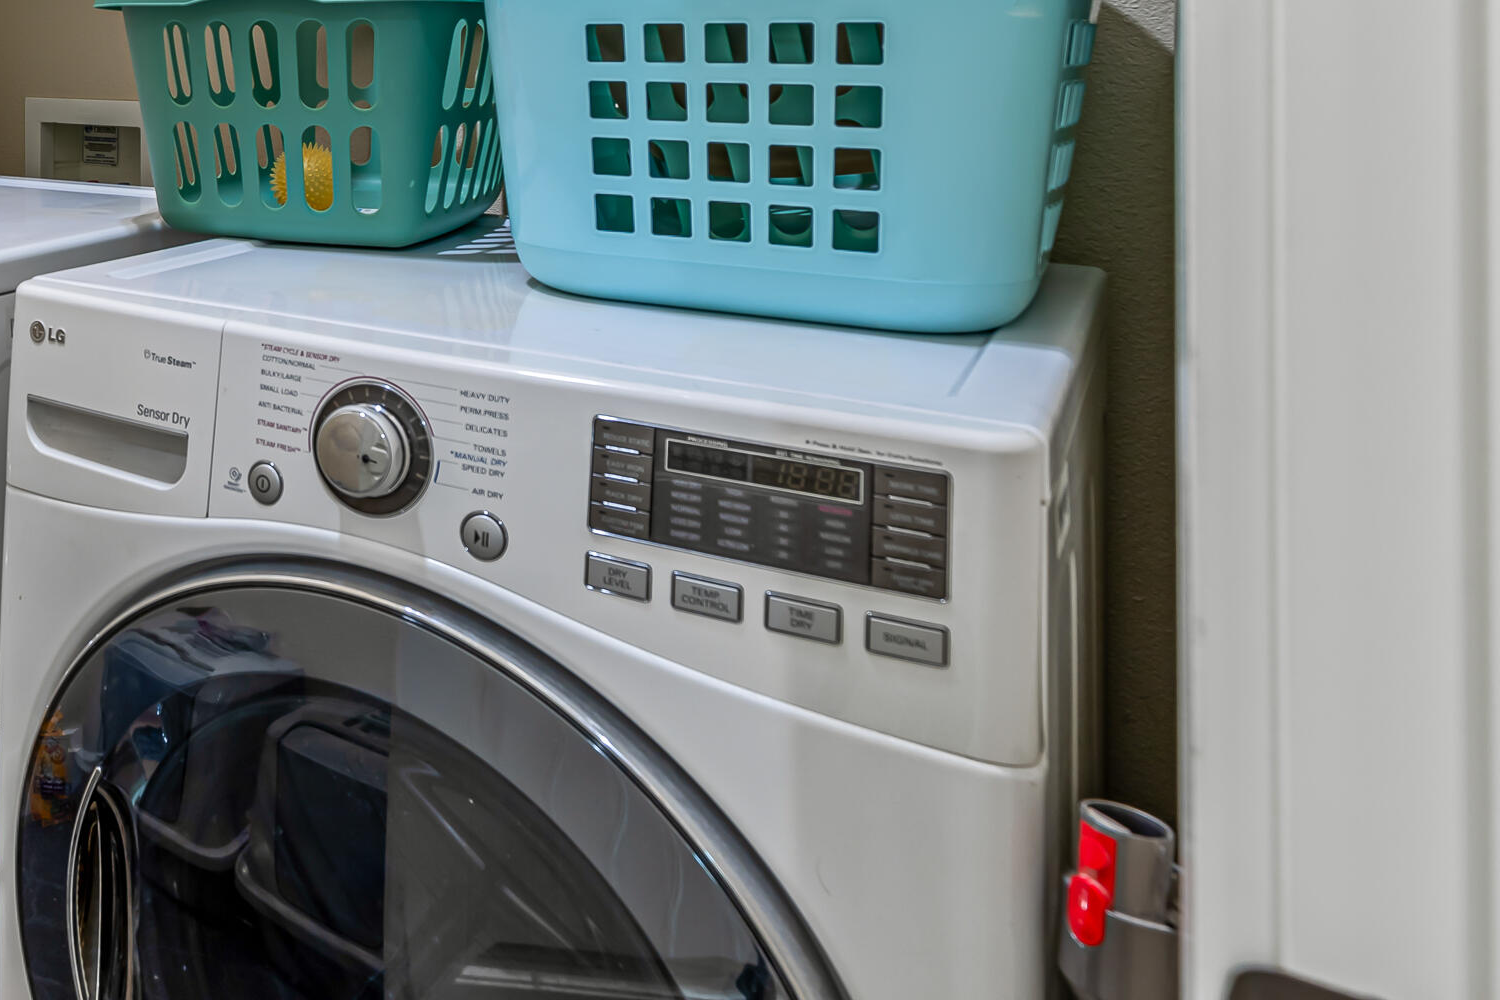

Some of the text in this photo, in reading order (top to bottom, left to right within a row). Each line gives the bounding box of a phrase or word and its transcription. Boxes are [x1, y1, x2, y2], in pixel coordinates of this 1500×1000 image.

[48, 327, 66, 344] LG
[281, 388, 298, 397] LOAD
[460, 390, 510, 404] HEAVY DUTY
[136, 404, 190, 428] Sensor Dry
[465, 424, 508, 438] DELICATES
[473, 444, 506, 457] TOWELS
[490, 458, 508, 468] DRY
[462, 464, 506, 478] SPEED DRY
[472, 488, 504, 500] AIR DRY
[608, 566, 628, 578] DRY
[603, 576, 632, 590] LEVEL
[682, 594, 730, 613] CONTROL
[788, 606, 814, 619] TIME
[790, 618, 812, 630] DRY
[882, 632, 927, 650] SIGNAL
